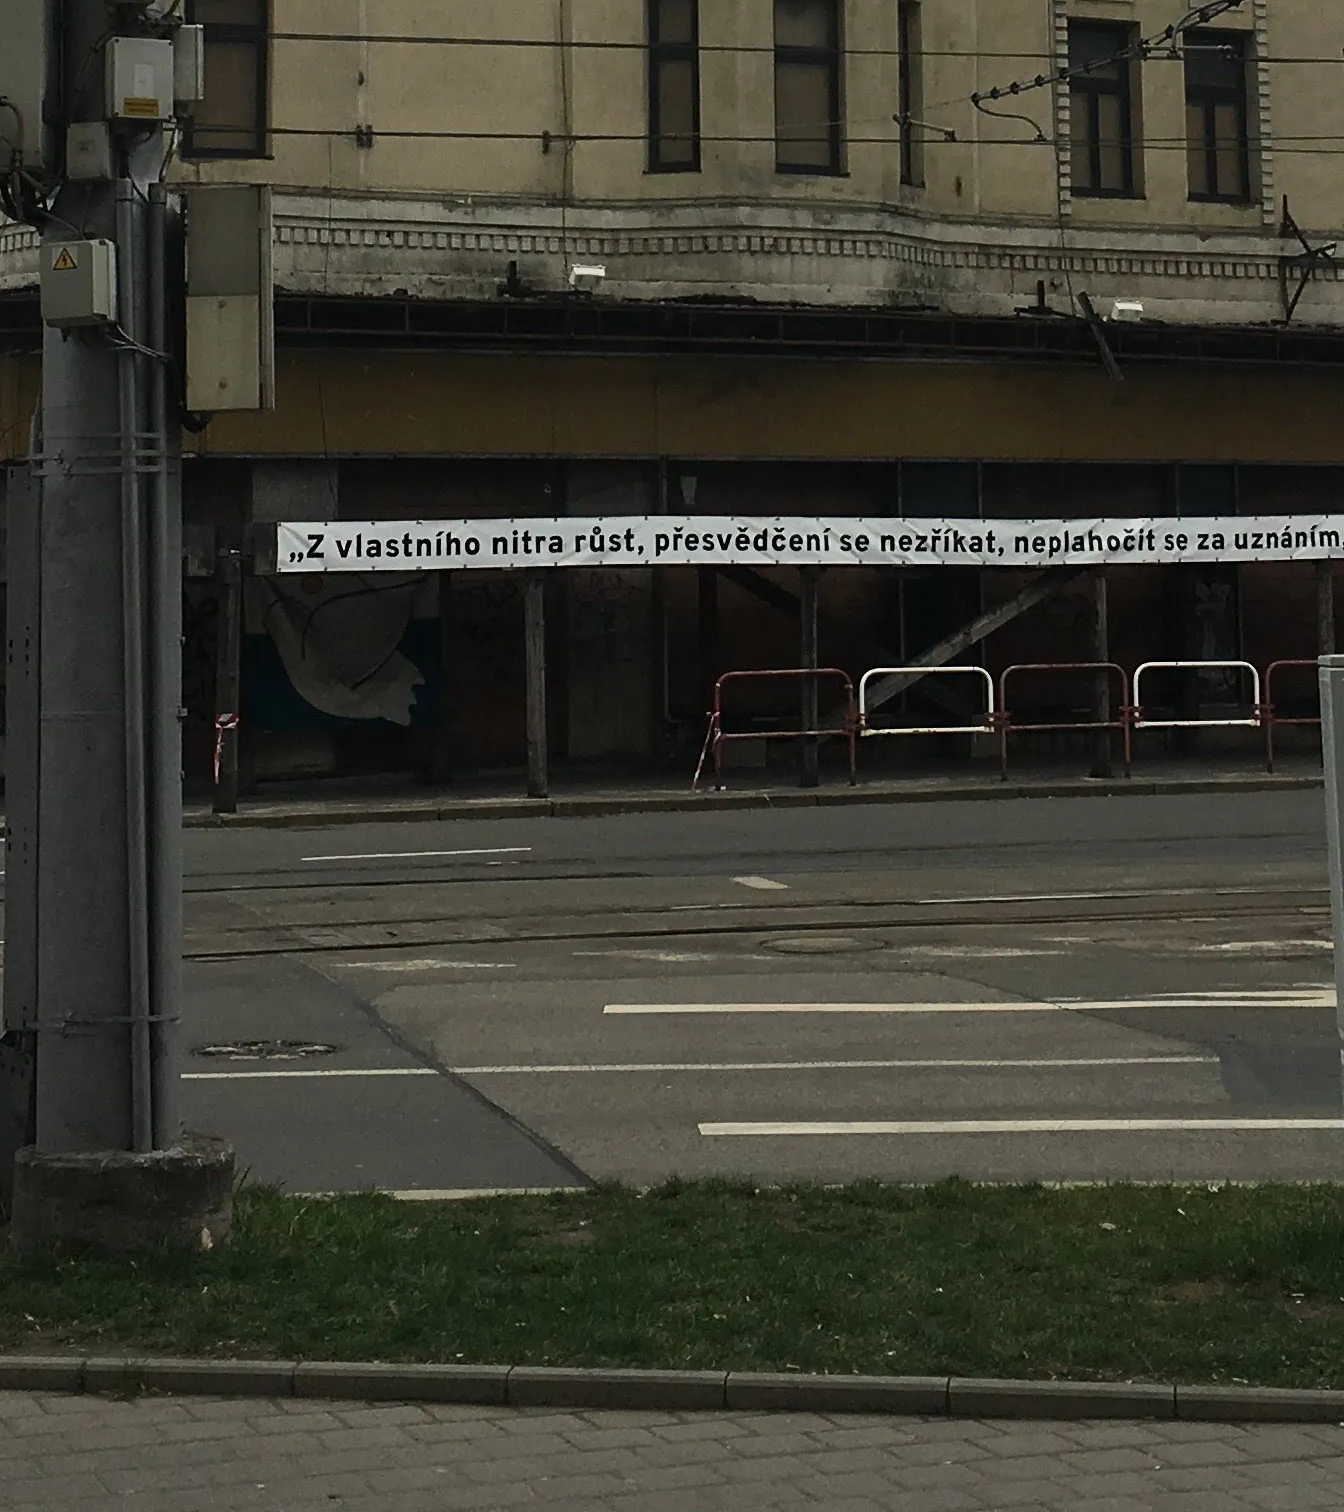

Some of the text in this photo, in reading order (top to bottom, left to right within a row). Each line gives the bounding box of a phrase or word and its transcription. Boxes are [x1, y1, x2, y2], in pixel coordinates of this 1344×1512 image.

[335, 531, 481, 559] vlastního
[492, 529, 564, 555] nitra
[574, 526, 645, 557] růst,
[654, 525, 831, 558] přesvědčení
[840, 534, 870, 553] se
[880, 527, 1005, 558] nezříkat,
[1014, 527, 1156, 559] neplahočit
[1164, 533, 1189, 552] se
[1197, 532, 1225, 551] za
